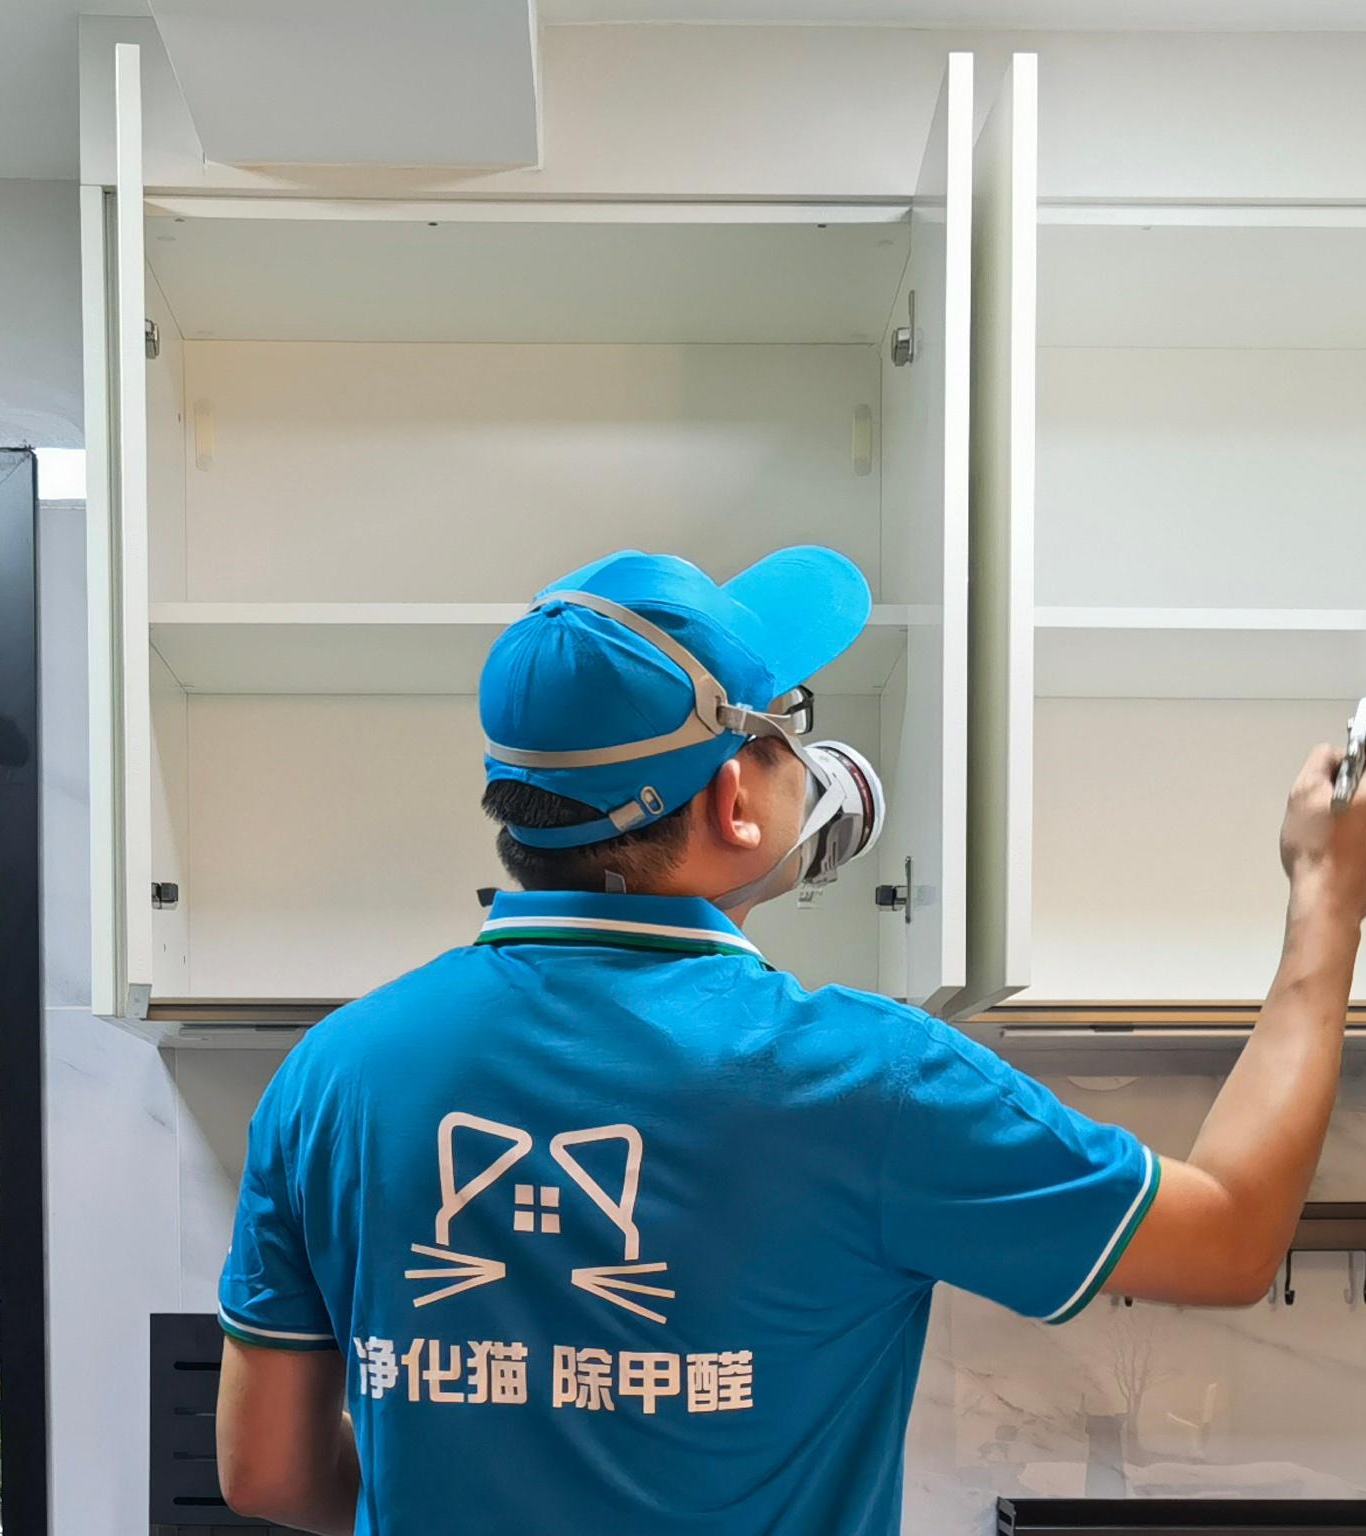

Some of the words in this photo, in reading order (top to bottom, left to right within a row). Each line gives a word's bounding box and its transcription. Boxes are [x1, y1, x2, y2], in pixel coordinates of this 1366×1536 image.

[353, 1335, 528, 1404] 净化猫
[552, 1345, 753, 1414] 除甲醛
